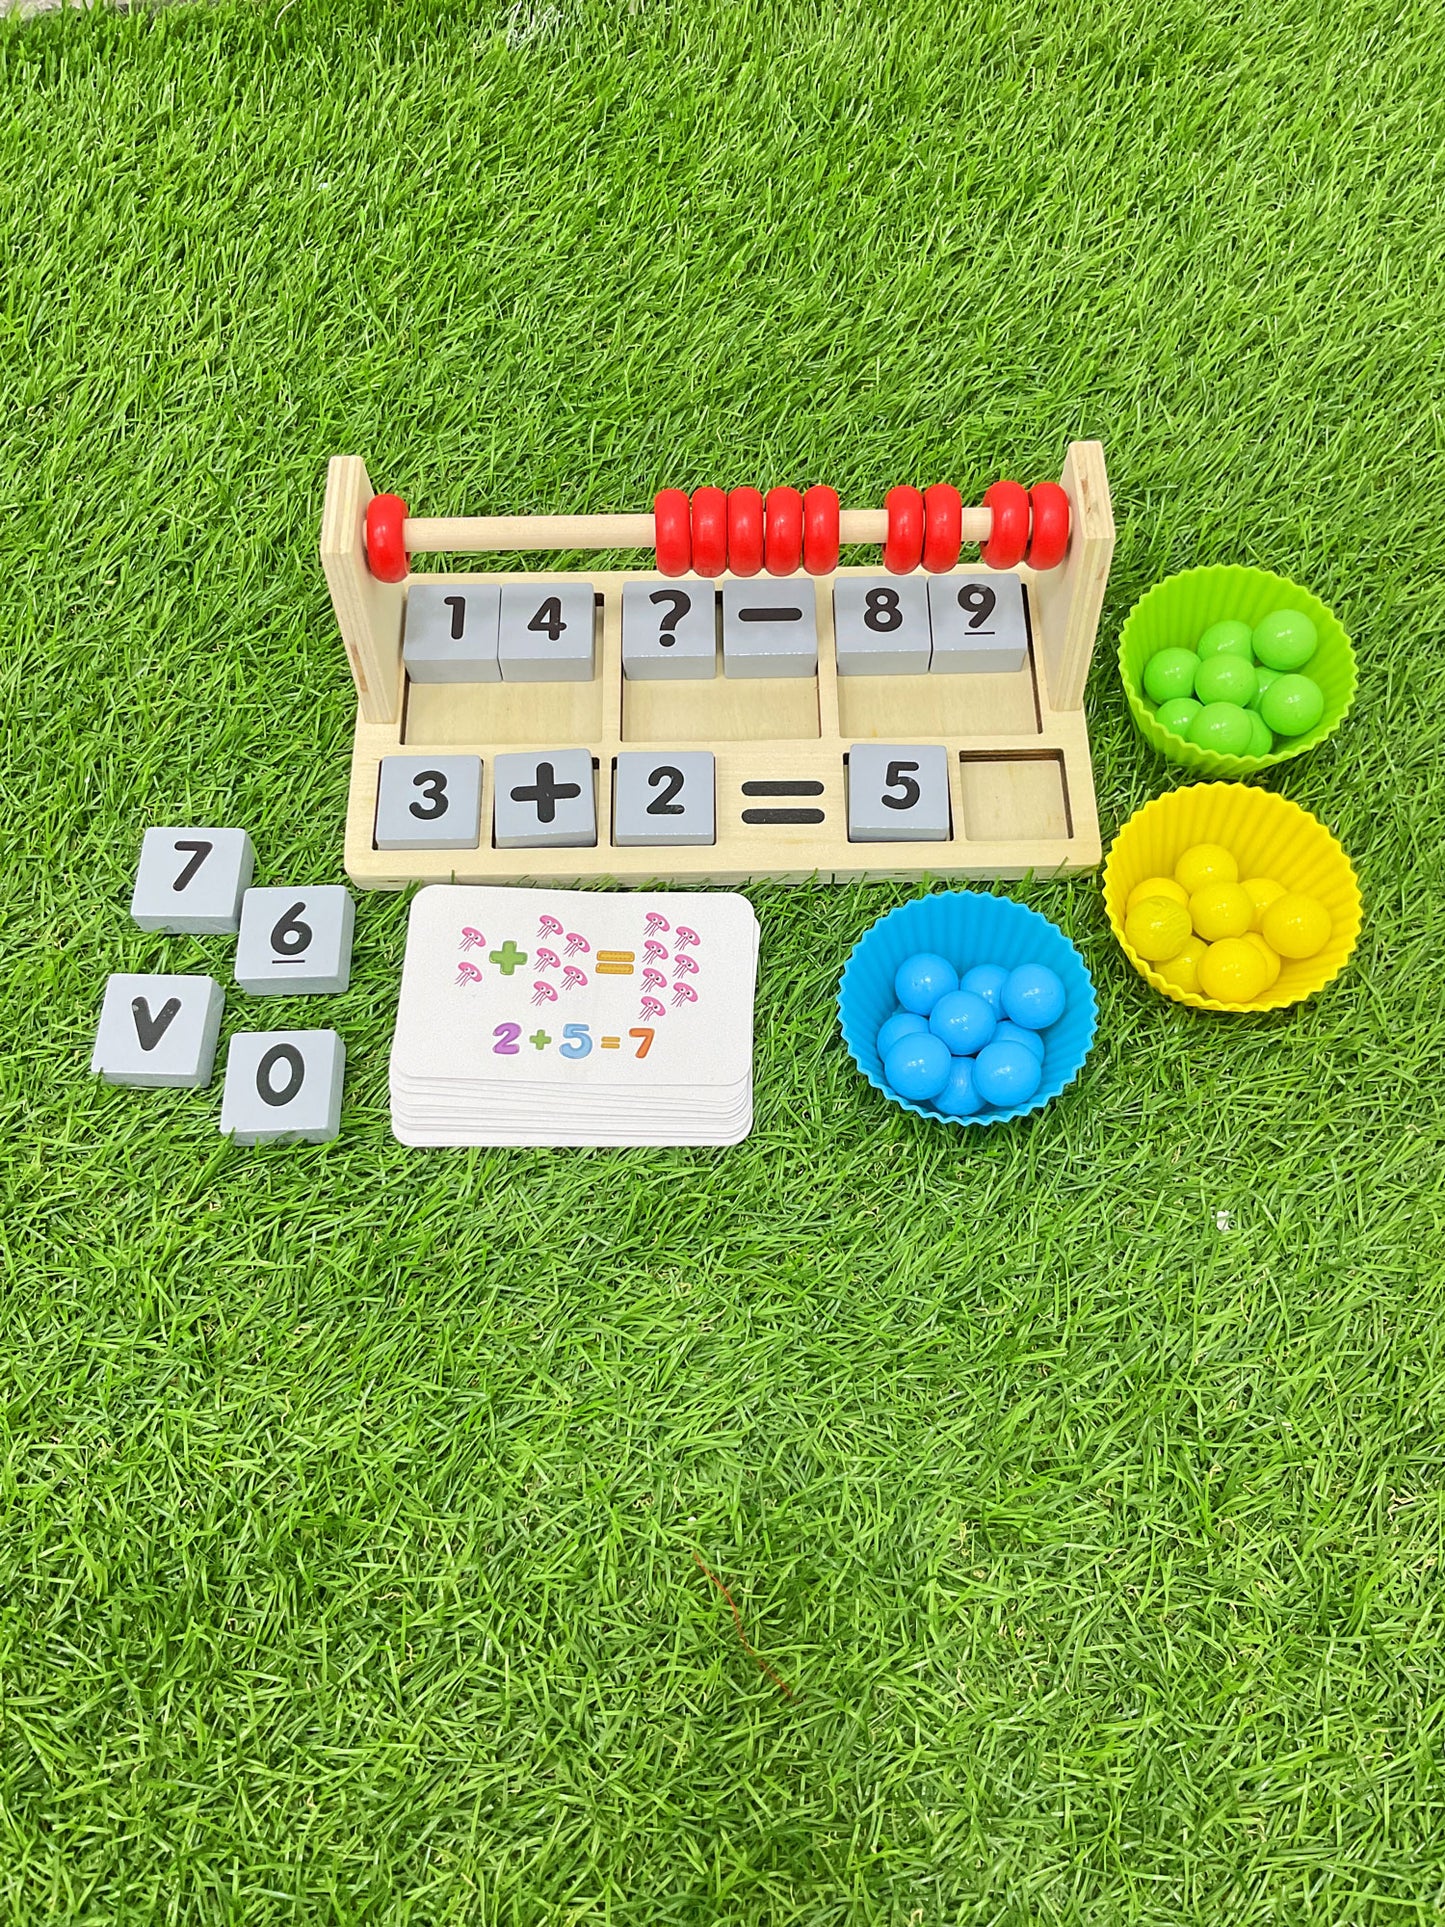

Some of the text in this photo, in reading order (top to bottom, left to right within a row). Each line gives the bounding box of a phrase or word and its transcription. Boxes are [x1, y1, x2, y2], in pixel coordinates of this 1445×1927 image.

[648, 589, 692, 648] ?
[408, 760, 922, 825] 3 + 2 = 5
[173, 840, 214, 892] 7
[269, 901, 314, 965] 6
